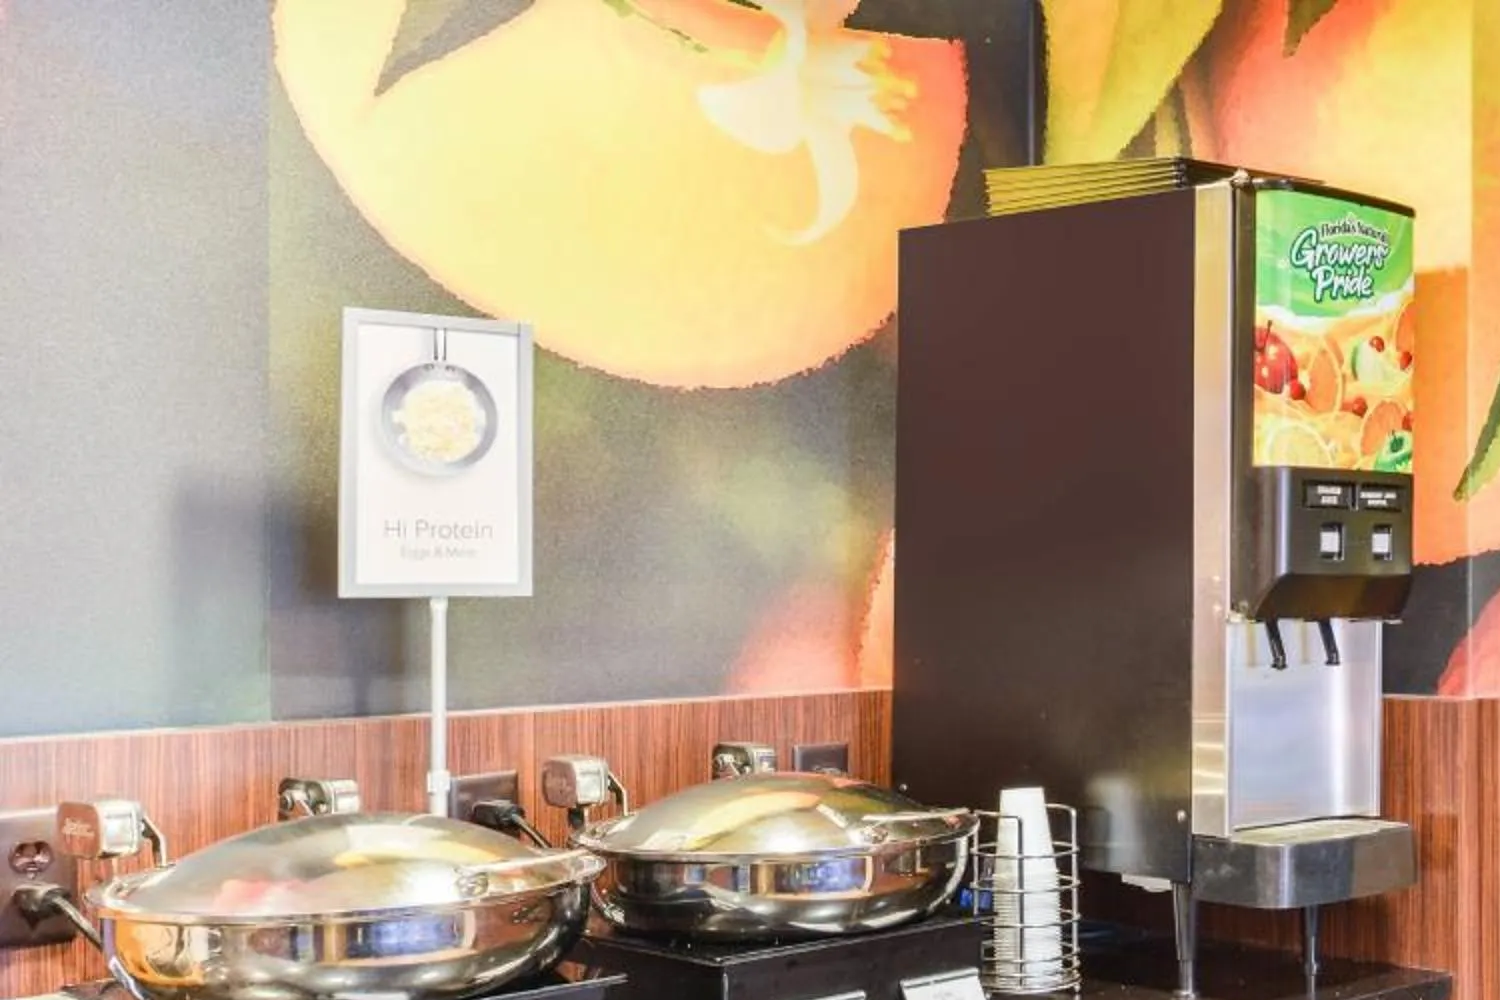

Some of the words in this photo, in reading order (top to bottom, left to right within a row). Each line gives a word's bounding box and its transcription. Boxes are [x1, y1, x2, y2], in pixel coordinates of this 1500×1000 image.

[1311, 265, 1374, 303] Pride
[383, 519, 407, 539] Hi
[415, 518, 494, 540] Protein
